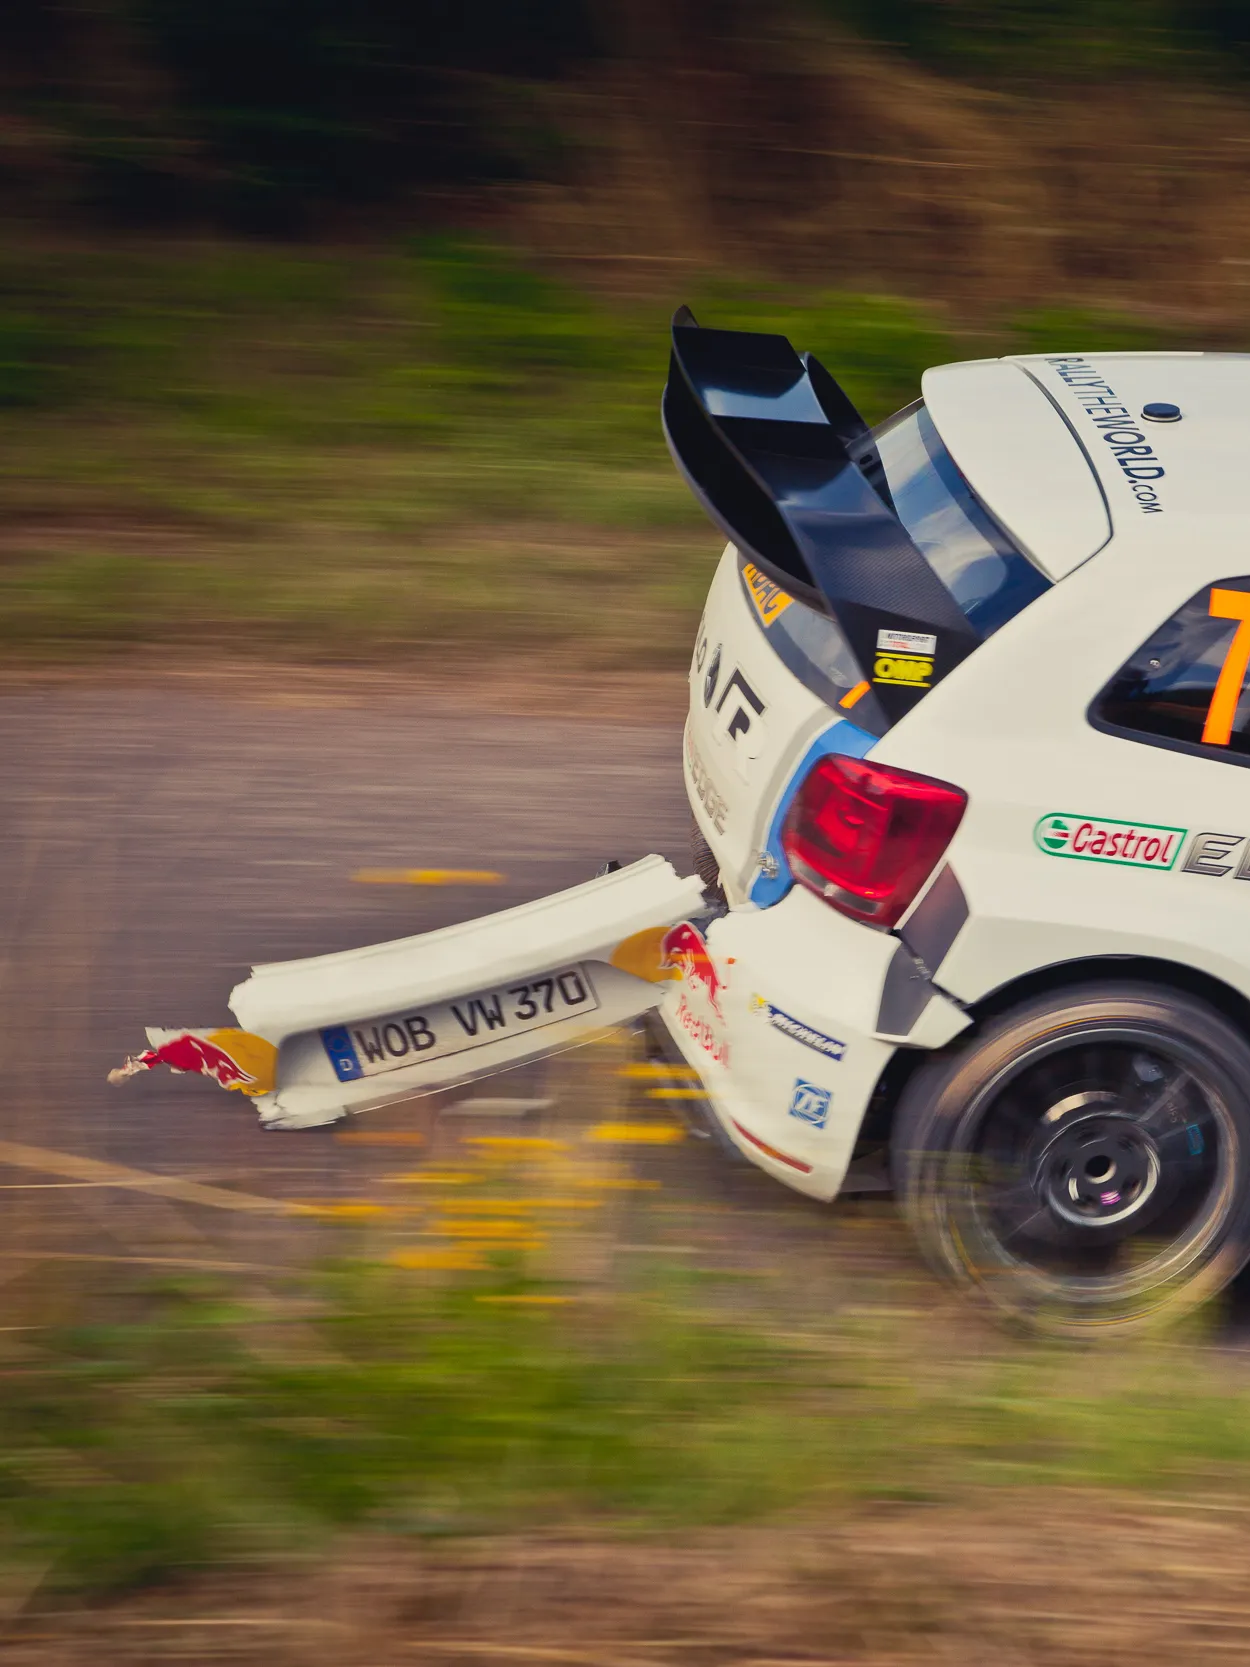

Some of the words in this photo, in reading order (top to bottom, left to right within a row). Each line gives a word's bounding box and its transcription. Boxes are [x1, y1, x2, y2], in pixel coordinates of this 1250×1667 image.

[873, 657, 934, 682] OMP
[1072, 823, 1174, 863] Castrol
[353, 1016, 437, 1064] WOB
[451, 994, 506, 1037] VW
[508, 971, 588, 1021] 370
